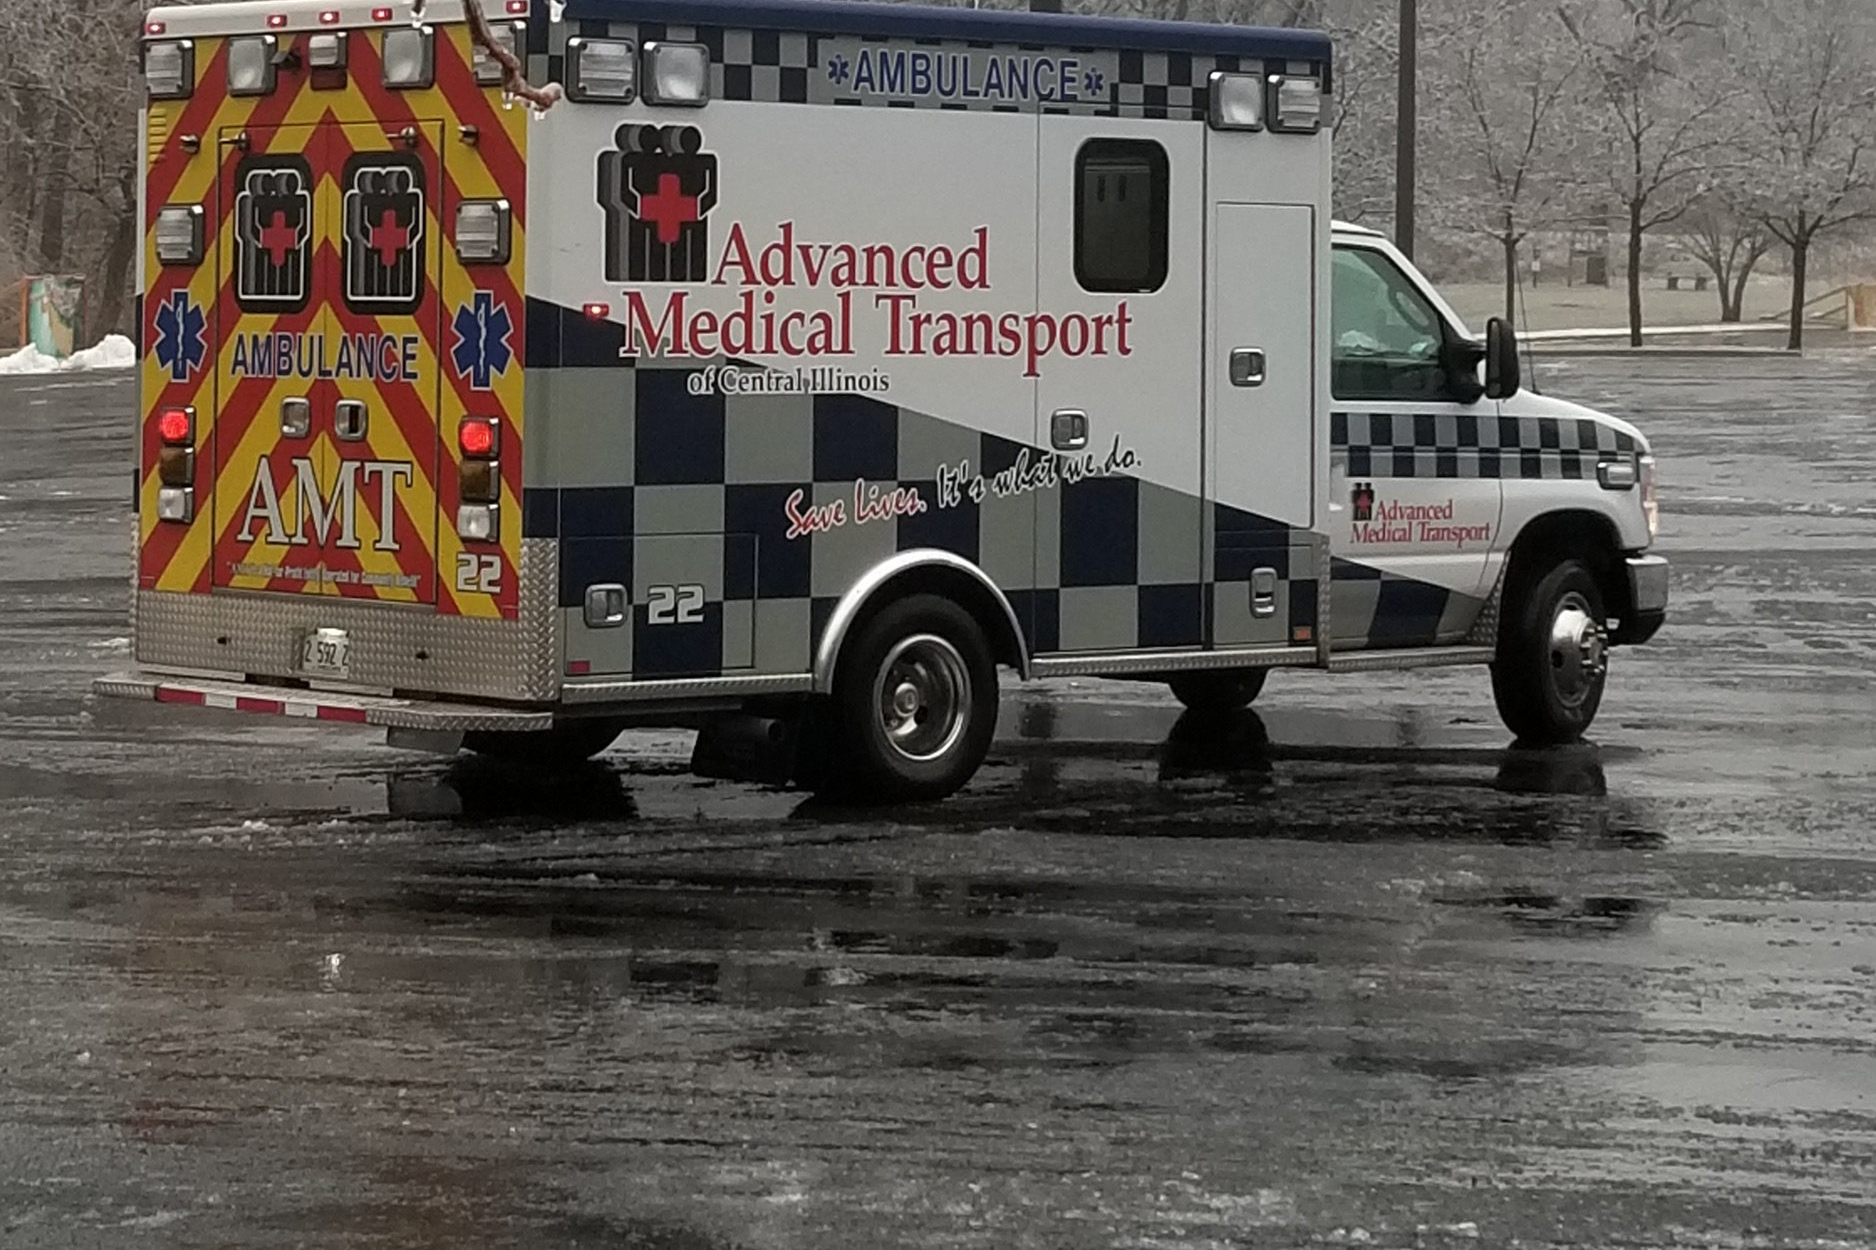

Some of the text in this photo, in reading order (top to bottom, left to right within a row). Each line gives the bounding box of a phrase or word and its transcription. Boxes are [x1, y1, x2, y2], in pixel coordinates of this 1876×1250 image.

[851, 47, 1081, 102] AMBULANCE
[711, 221, 991, 290] Advanced
[231, 332, 419, 380] AMBULANCE
[619, 289, 1132, 377] Medical Transport
[686, 366, 890, 395] of Central Illinois
[236, 454, 413, 550] AMT
[784, 433, 1143, 539] Save Lives. It's what we do.
[1374, 498, 1454, 522] Advanced
[1350, 521, 1491, 549] Medical Transport
[455, 553, 502, 593] 22
[646, 584, 705, 626] 22
